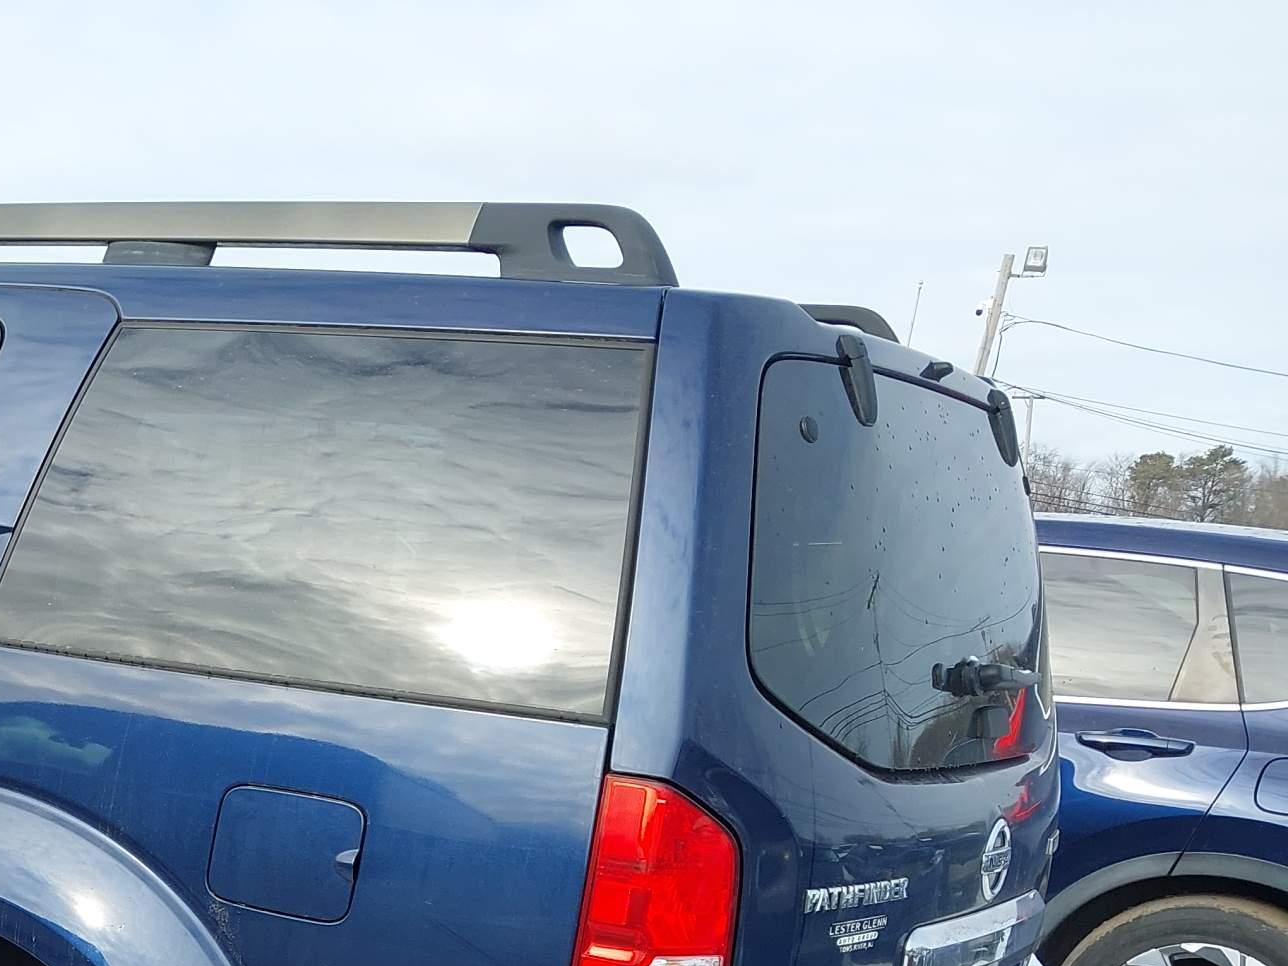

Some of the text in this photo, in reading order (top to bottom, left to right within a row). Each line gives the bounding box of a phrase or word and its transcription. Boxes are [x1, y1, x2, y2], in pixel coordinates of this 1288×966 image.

[804, 878, 909, 914] PATHFINDER
[829, 916, 888, 936] LESTER GLENN
